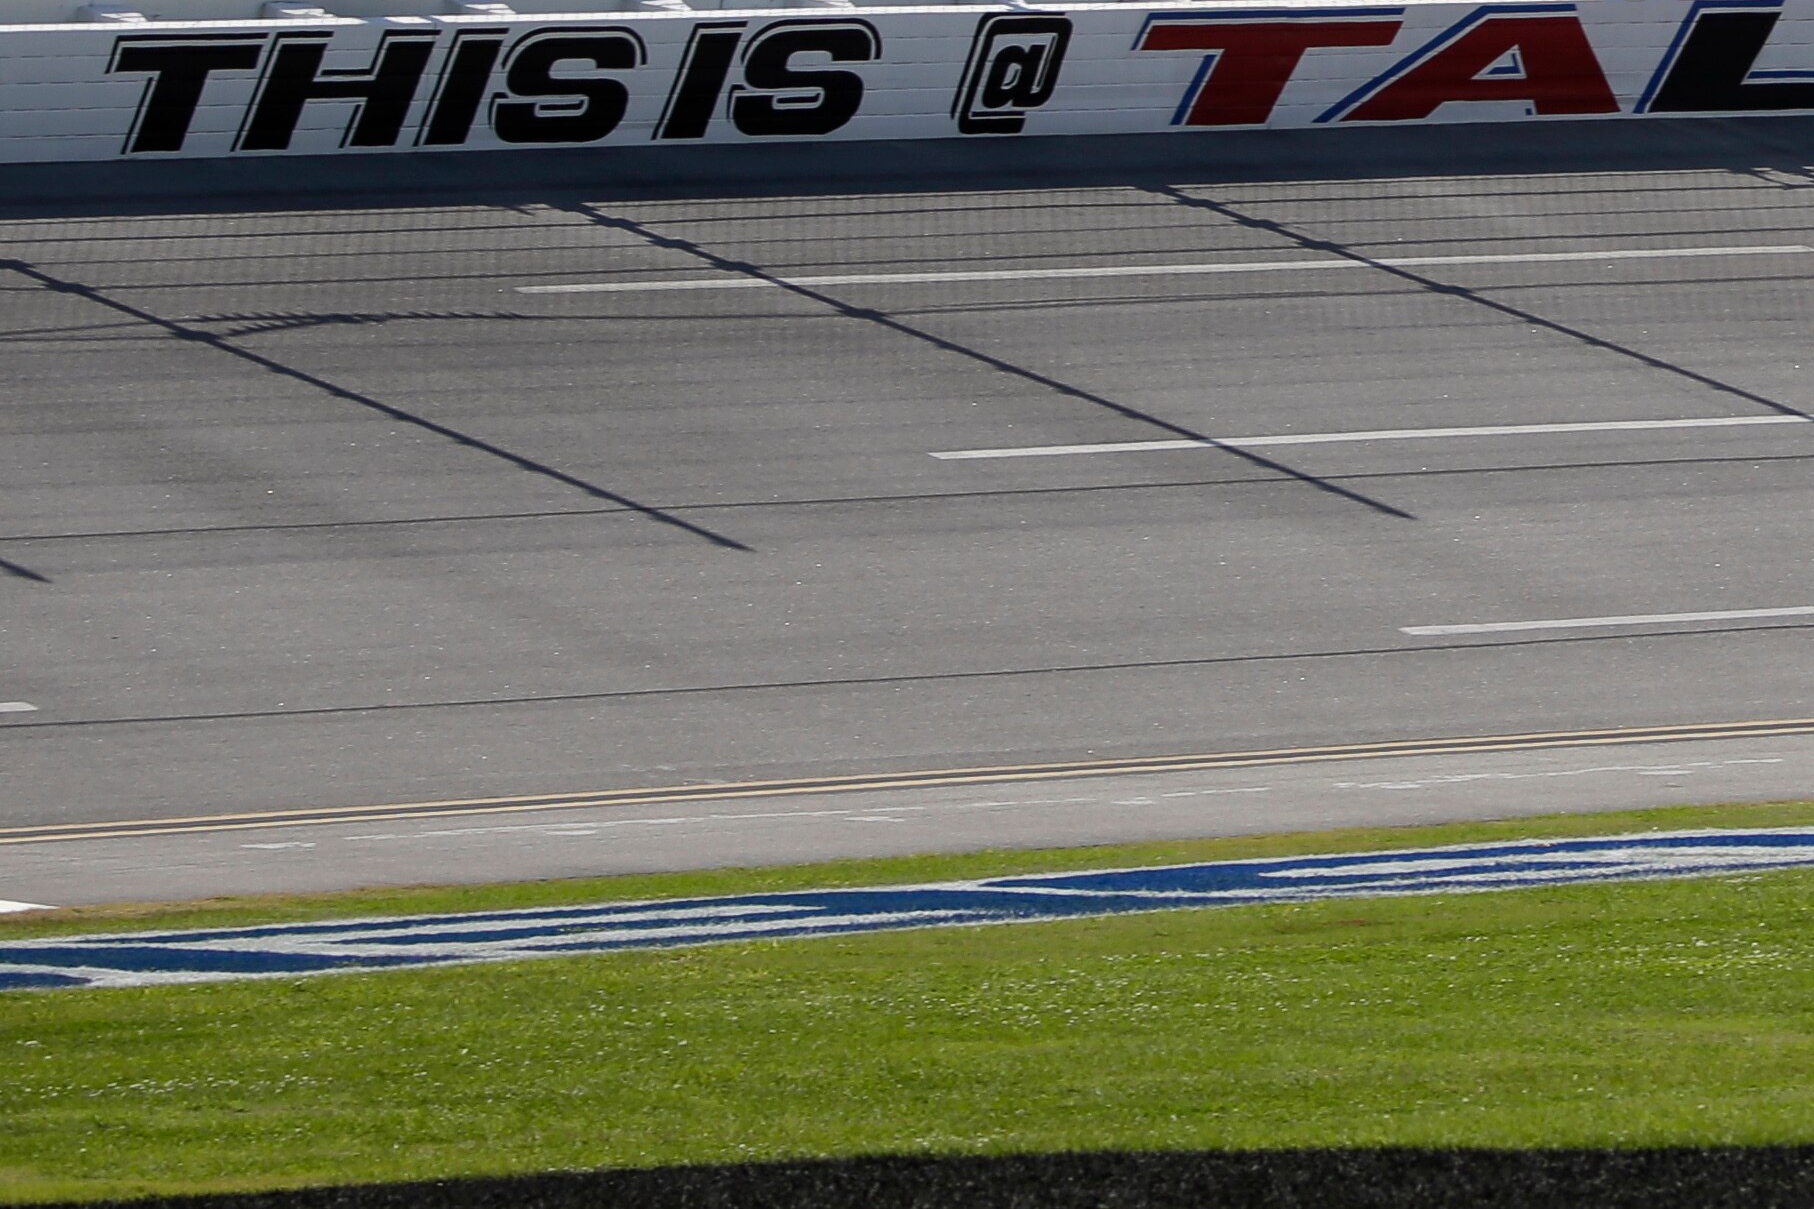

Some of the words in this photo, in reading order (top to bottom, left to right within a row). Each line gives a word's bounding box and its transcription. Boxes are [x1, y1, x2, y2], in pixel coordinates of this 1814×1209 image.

[105, 26, 648, 155] THIS
[653, 18, 882, 140] IS
[951, 12, 1074, 135] @
